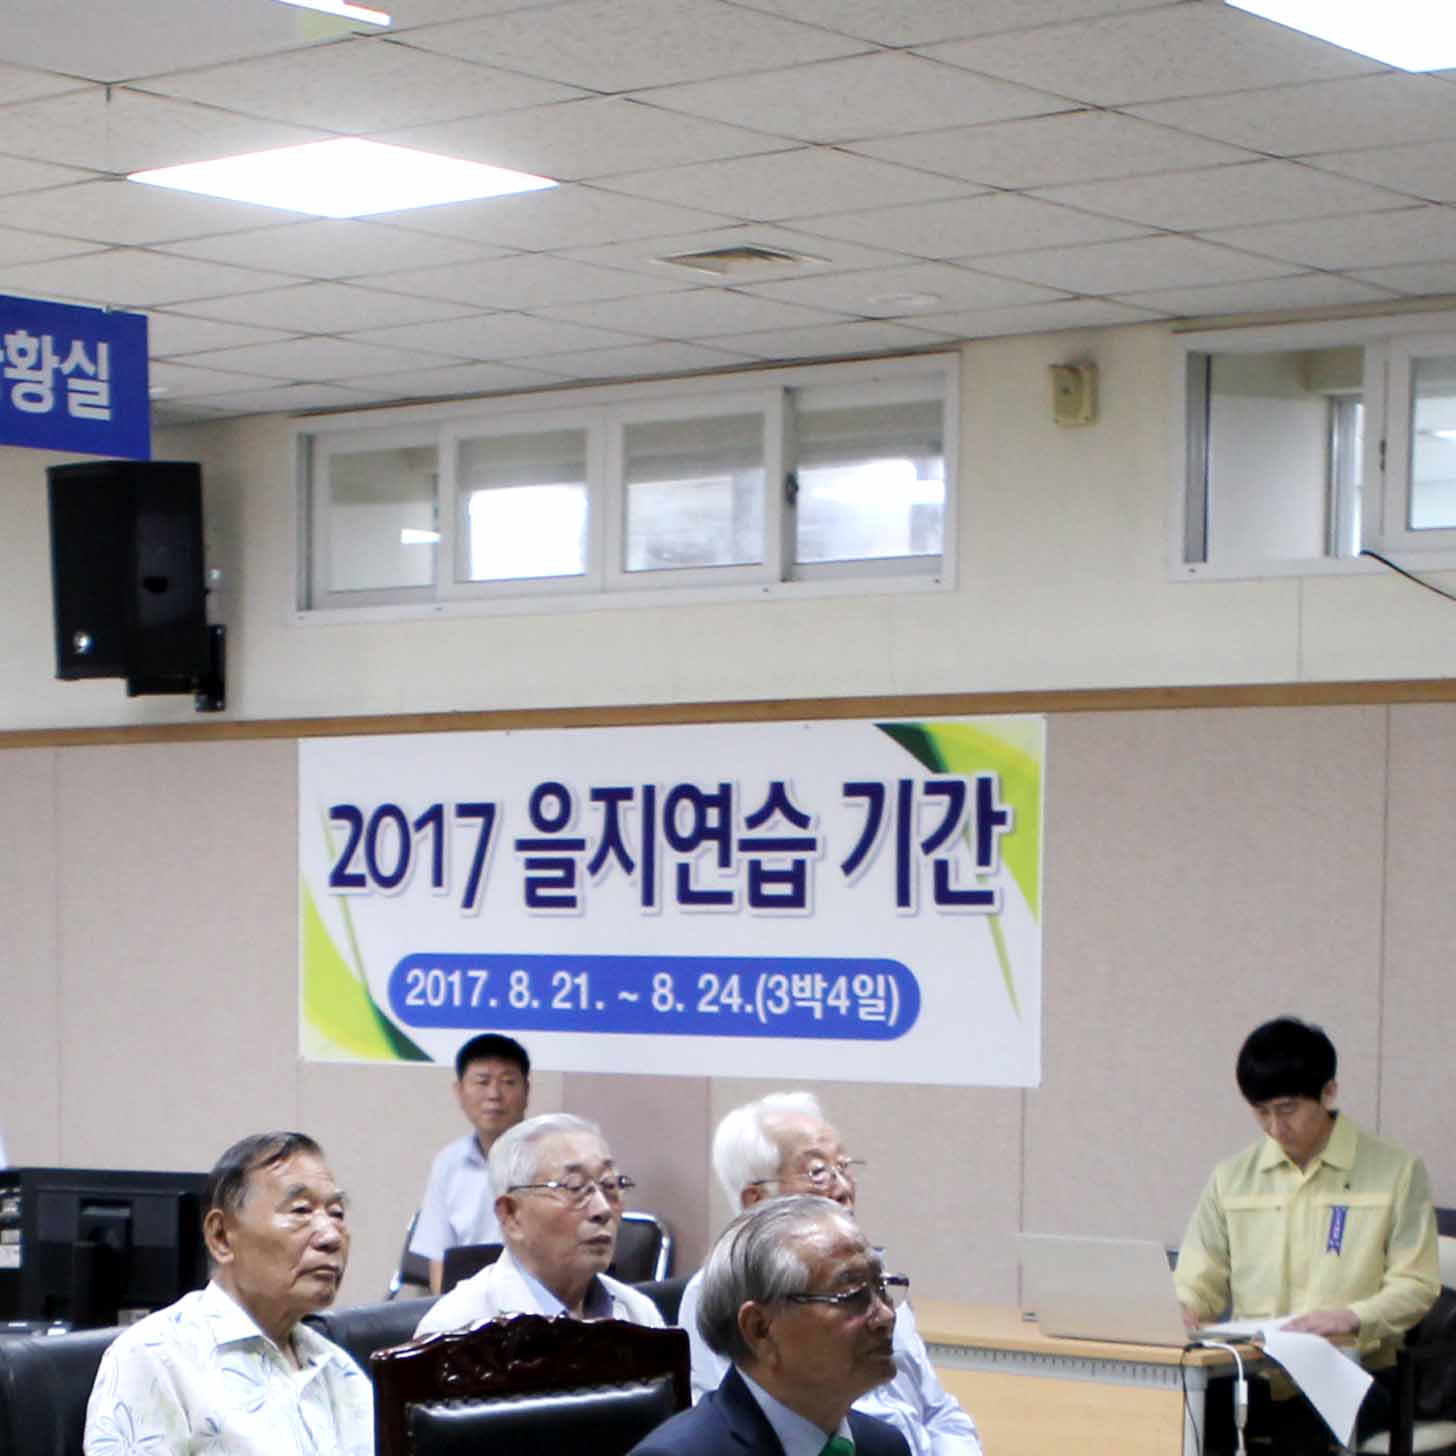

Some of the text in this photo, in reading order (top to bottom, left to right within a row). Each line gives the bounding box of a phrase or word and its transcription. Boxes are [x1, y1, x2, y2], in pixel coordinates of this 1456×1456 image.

[329, 776, 1007, 909] 2017 을지연습 기간
[404, 968, 499, 1008] 2017.
[508, 969, 541, 1009] 8.
[550, 970, 606, 1011] 21.
[650, 971, 685, 1013] 8.
